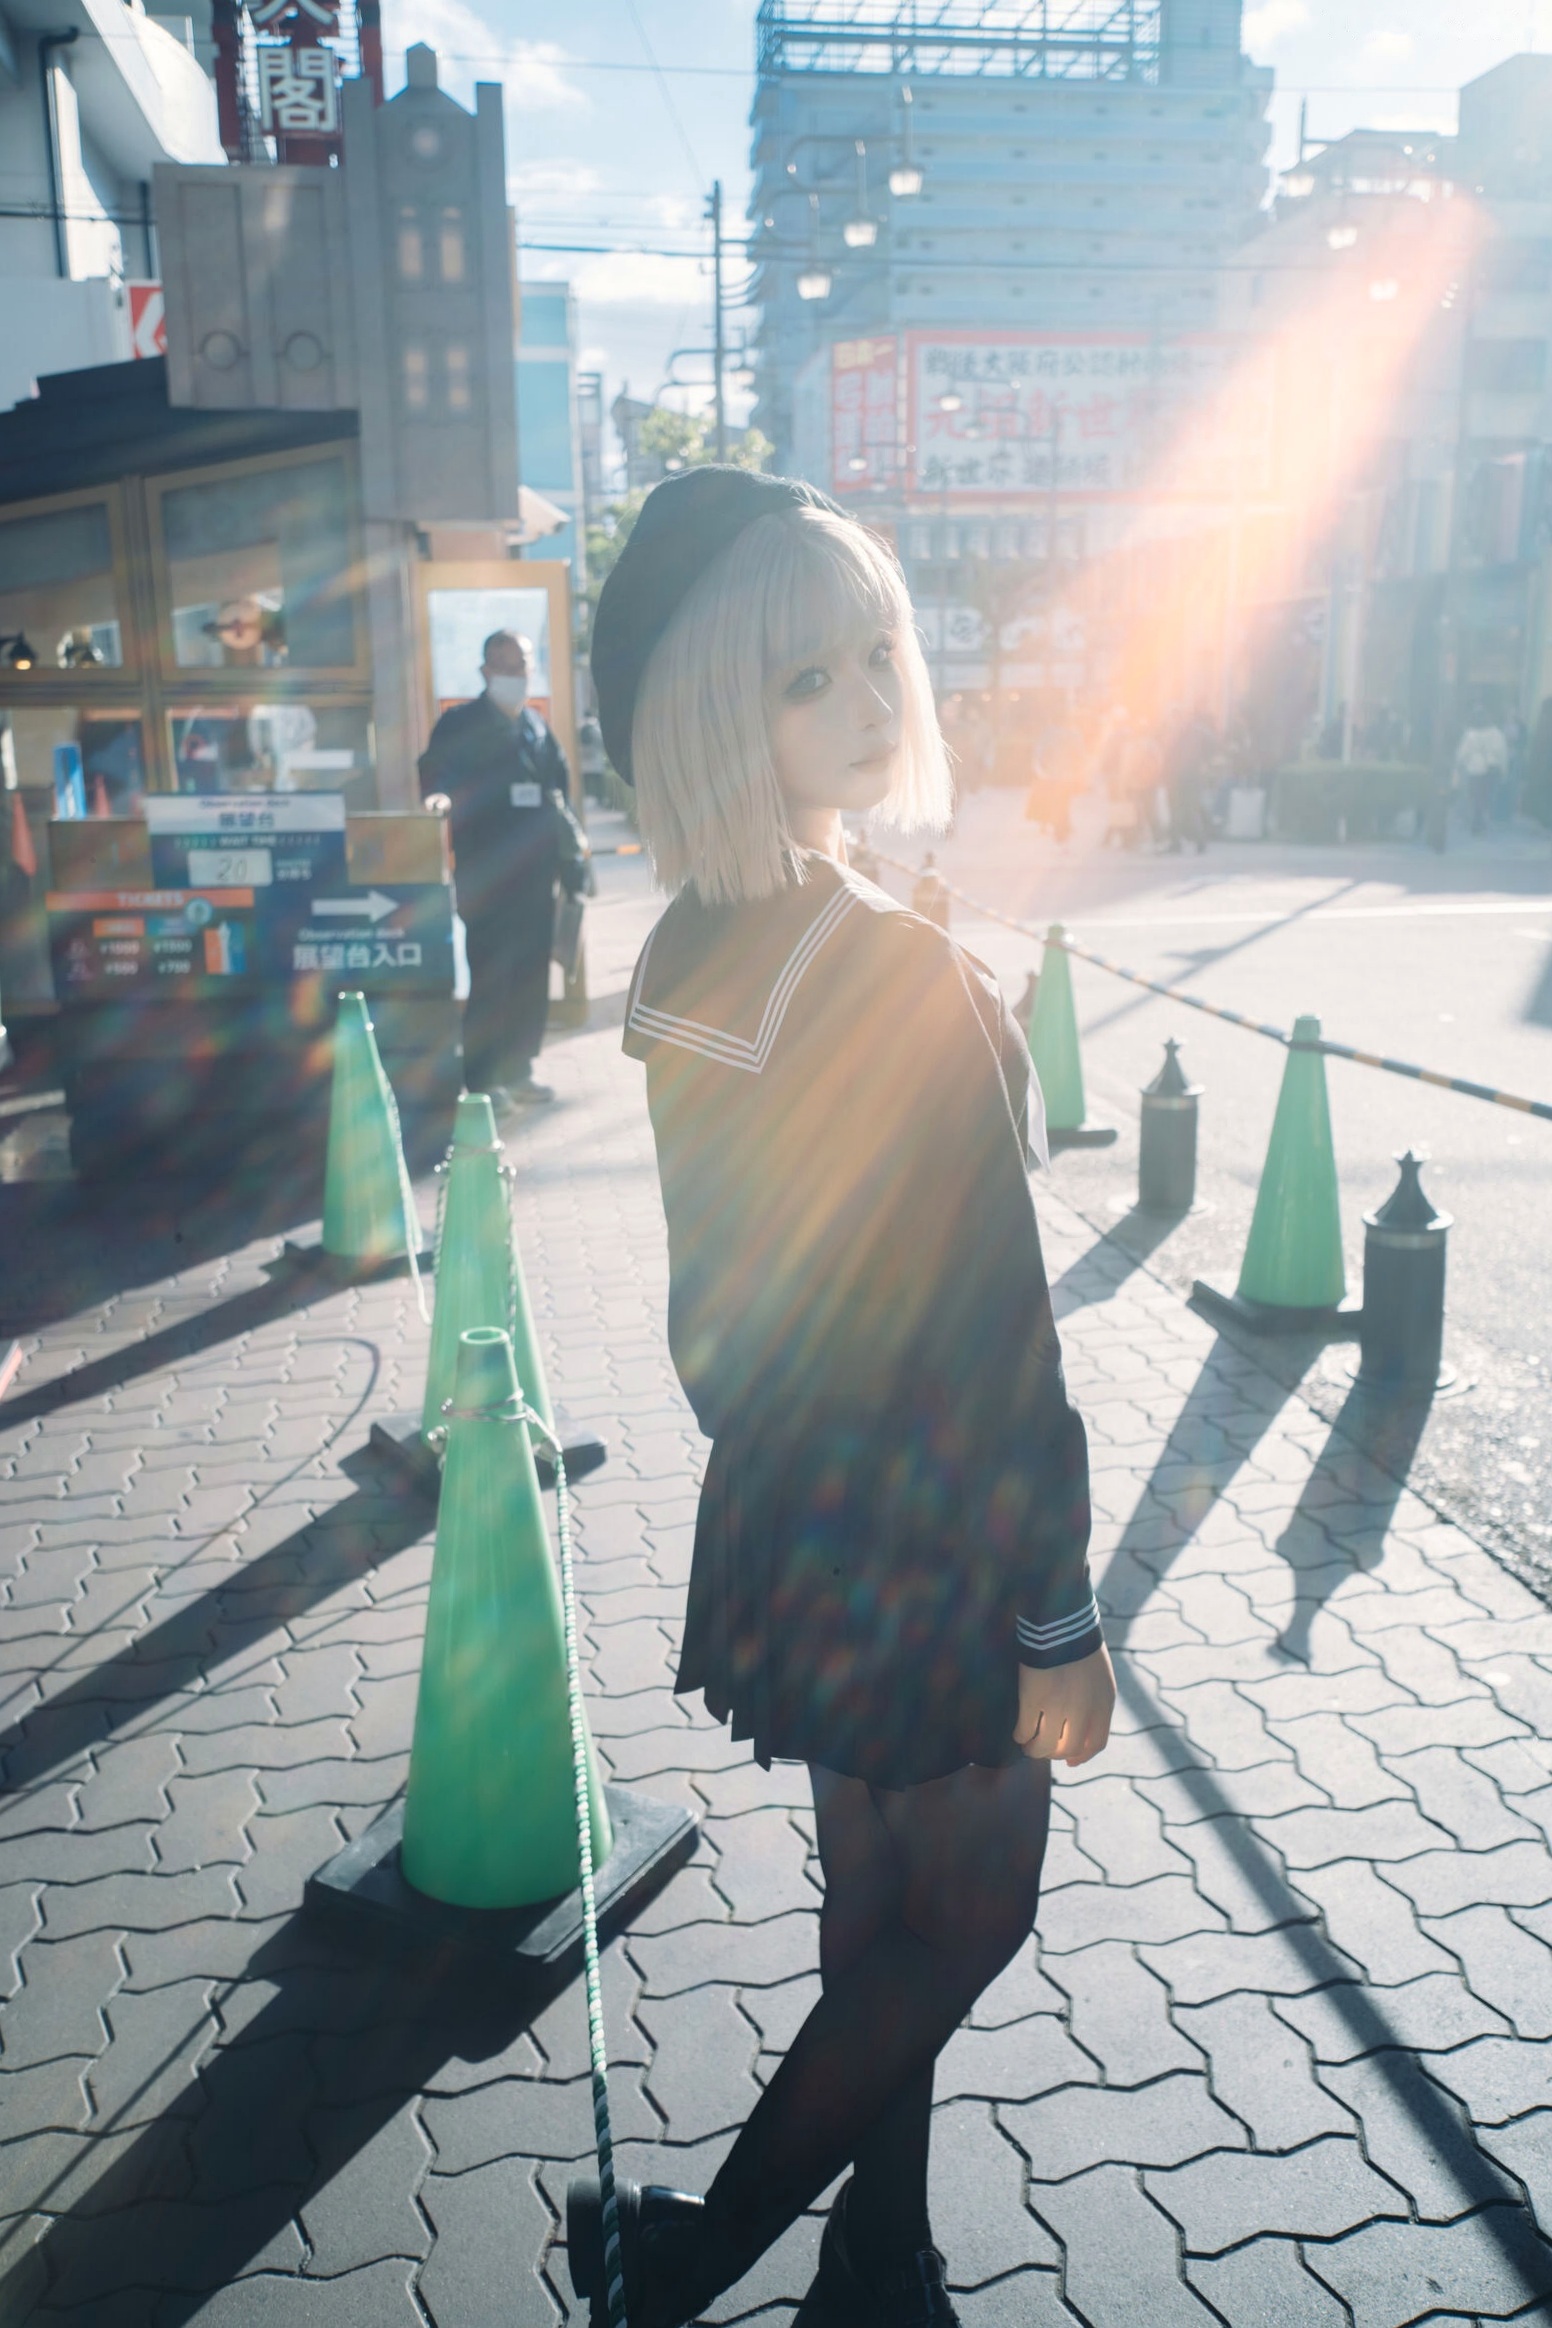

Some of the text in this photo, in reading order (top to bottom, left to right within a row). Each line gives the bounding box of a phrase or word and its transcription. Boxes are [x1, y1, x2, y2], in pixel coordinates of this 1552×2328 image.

[220, 811, 274, 828] 展望台
[216, 856, 248, 881] 20
[117, 891, 185, 906] TICKETS
[293, 943, 421, 970] 展望台入口
